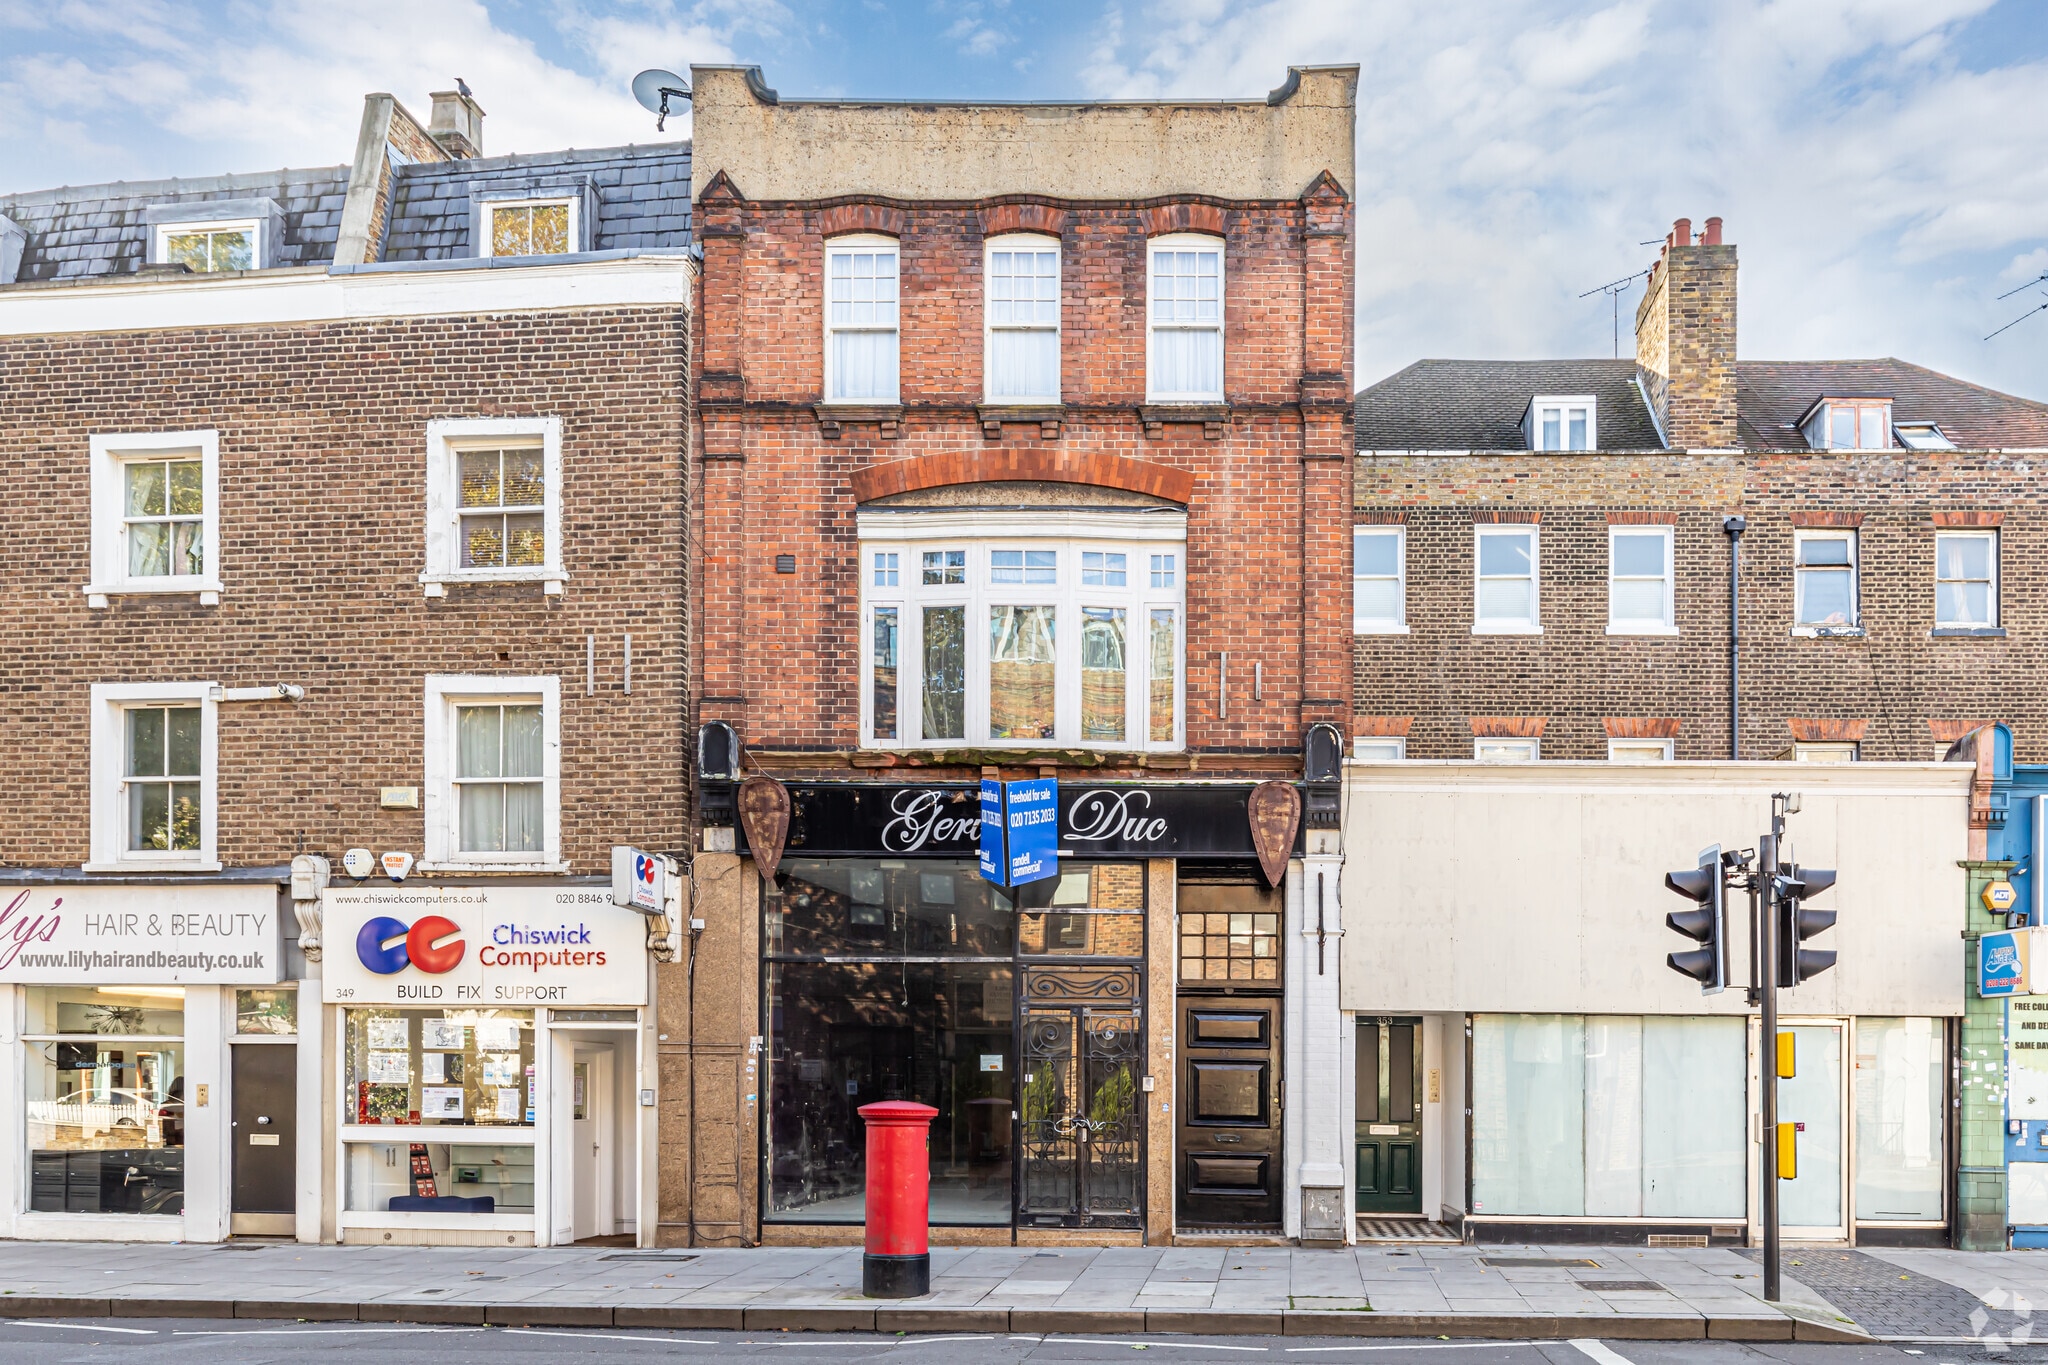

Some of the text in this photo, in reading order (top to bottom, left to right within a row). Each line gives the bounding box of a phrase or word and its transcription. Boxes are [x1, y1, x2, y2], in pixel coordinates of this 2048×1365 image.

[1010, 790, 1032, 804] freehold
[1032, 789, 1041, 801] for
[1041, 788, 1051, 801] sale
[1011, 812, 1023, 828] 020
[1024, 810, 1040, 825] 7135
[1041, 808, 1055, 823] 2033
[1063, 790, 1168, 841] Duc
[1013, 852, 1030, 867] randell
[336, 893, 488, 906] www.chiswickcomputers.co.uk
[556, 894, 575, 904] 020
[577, 894, 603, 904] 8846
[1994, 891, 2009, 899] ADT
[85, 914, 138, 936] HAIR
[147, 914, 163, 936] &
[171, 914, 267, 936] BEAUTY
[493, 923, 591, 945] Chiswick
[1987, 948, 2014, 965] ANGELS
[1995, 946, 2014, 955] LAPTOP
[20, 951, 264, 972] www.lilyhairandbeauty.co.uk
[479, 946, 607, 972] Computers
[336, 988, 354, 998] 349
[397, 985, 567, 999] BUILD FIX SUPPORT
[2014, 1003, 2031, 1011] FREE
[1377, 1016, 1393, 1025] 353
[2021, 1022, 2036, 1030] AND
[2015, 1042, 2035, 1050] SAME
